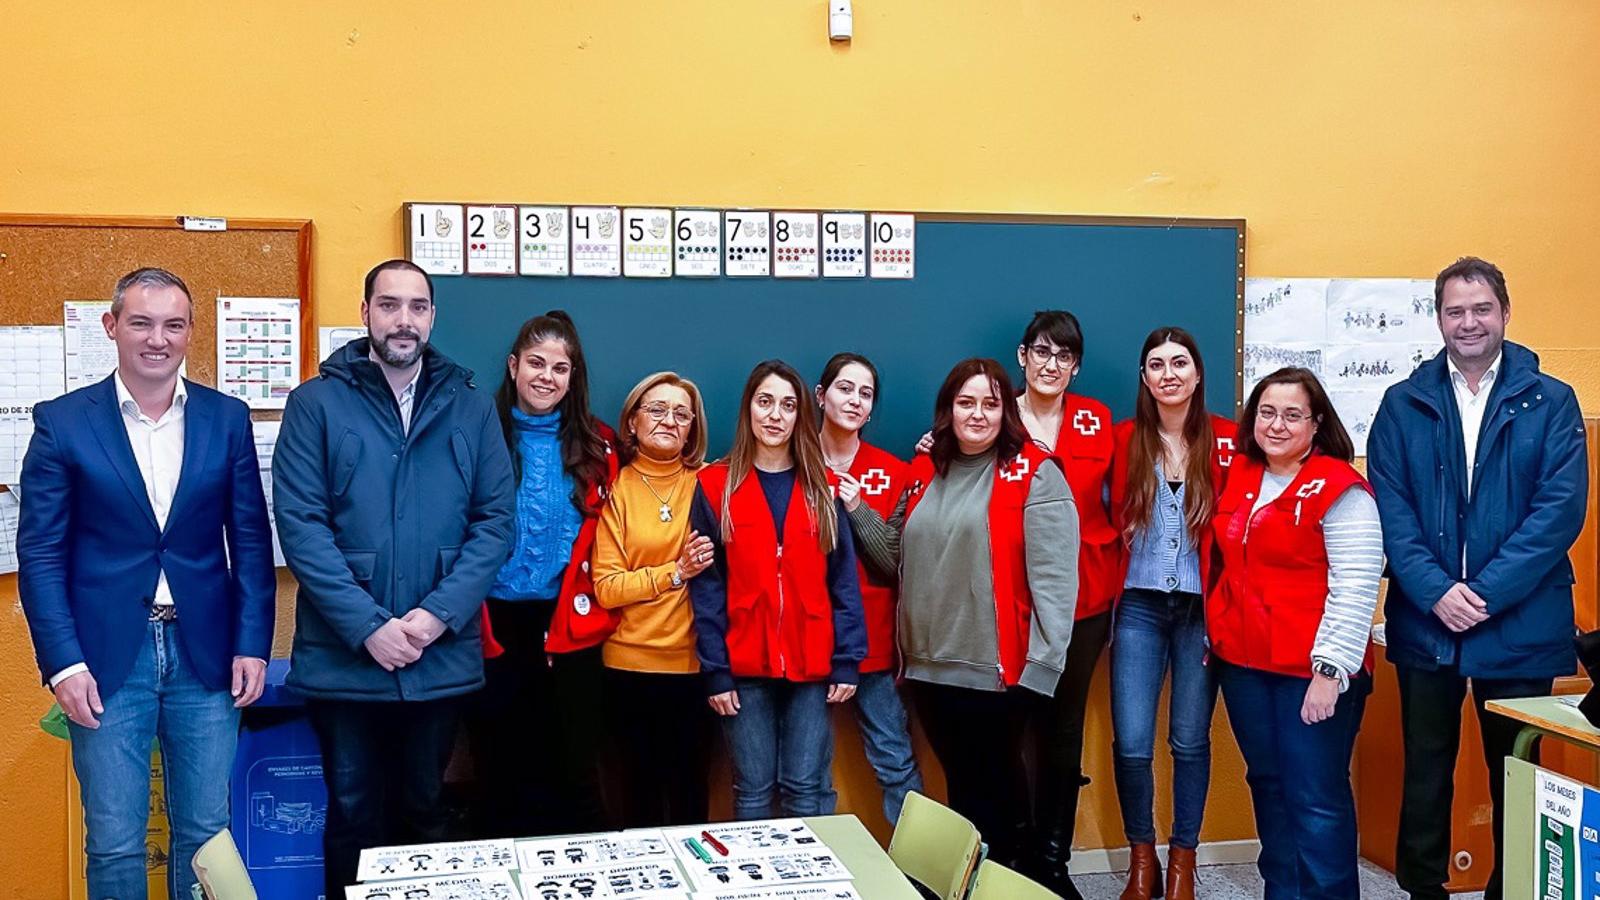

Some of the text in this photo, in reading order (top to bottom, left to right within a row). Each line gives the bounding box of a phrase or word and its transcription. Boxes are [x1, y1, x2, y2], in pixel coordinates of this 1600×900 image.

[420, 213, 425, 236] 1
[470, 214, 485, 237] 2
[526, 214, 541, 237] 3
[576, 216, 589, 239] 4
[629, 218, 644, 241] 5
[677, 218, 692, 240] 6
[727, 219, 742, 241] 7
[776, 219, 789, 242] 8
[825, 221, 839, 243] 9
[873, 222, 893, 243] 10
[1545, 781, 1576, 800] LOS MESES
[1546, 800, 1571, 817] DEL AÑO
[1584, 828, 1597, 840] DÍA
